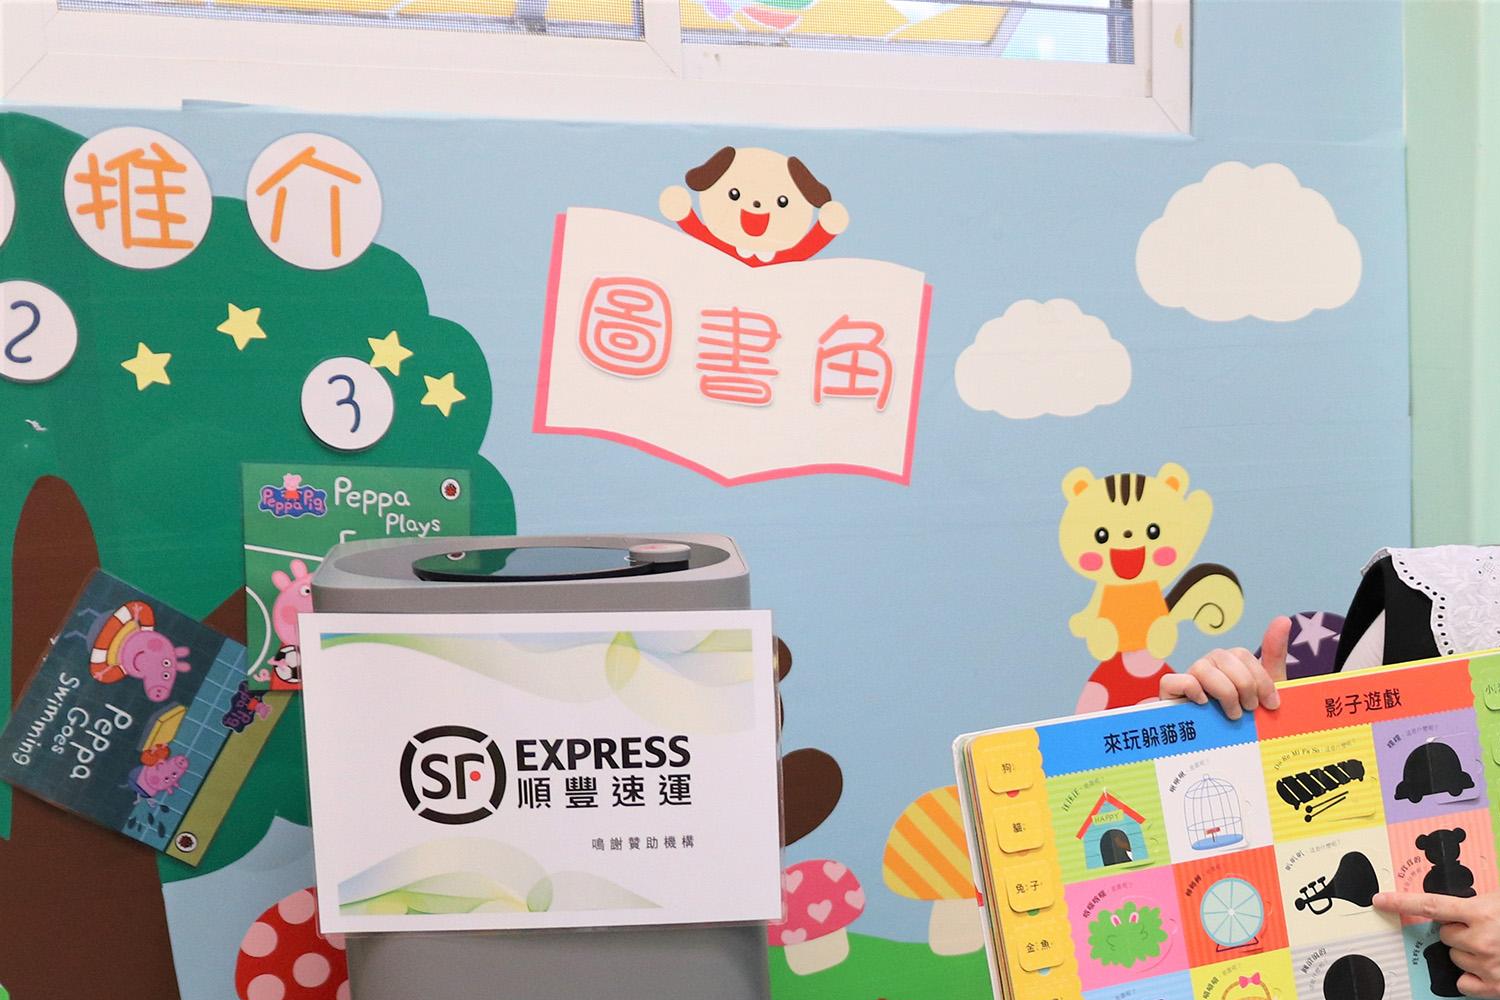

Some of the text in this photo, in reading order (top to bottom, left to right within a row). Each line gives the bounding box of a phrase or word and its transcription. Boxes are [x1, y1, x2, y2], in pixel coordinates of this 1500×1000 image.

[73, 142, 362, 258] 推介
[3, 299, 41, 364] 2
[578, 277, 895, 412] 圖書角
[327, 374, 362, 434] 3
[262, 488, 325, 515] Peppa Pig
[334, 476, 411, 517] Peppa
[386, 512, 441, 538] Plays
[12, 672, 81, 766] Swimming
[1325, 688, 1402, 718] 影子遊戲
[50, 706, 90, 755] Goes
[69, 703, 133, 780] Peppa
[1103, 719, 1197, 755] 來玩躲貓貓
[420, 735, 691, 800] SF EXPRESS
[517, 773, 692, 810] 順豐速運
[592, 834, 695, 851] 鳴謝贊助機構
